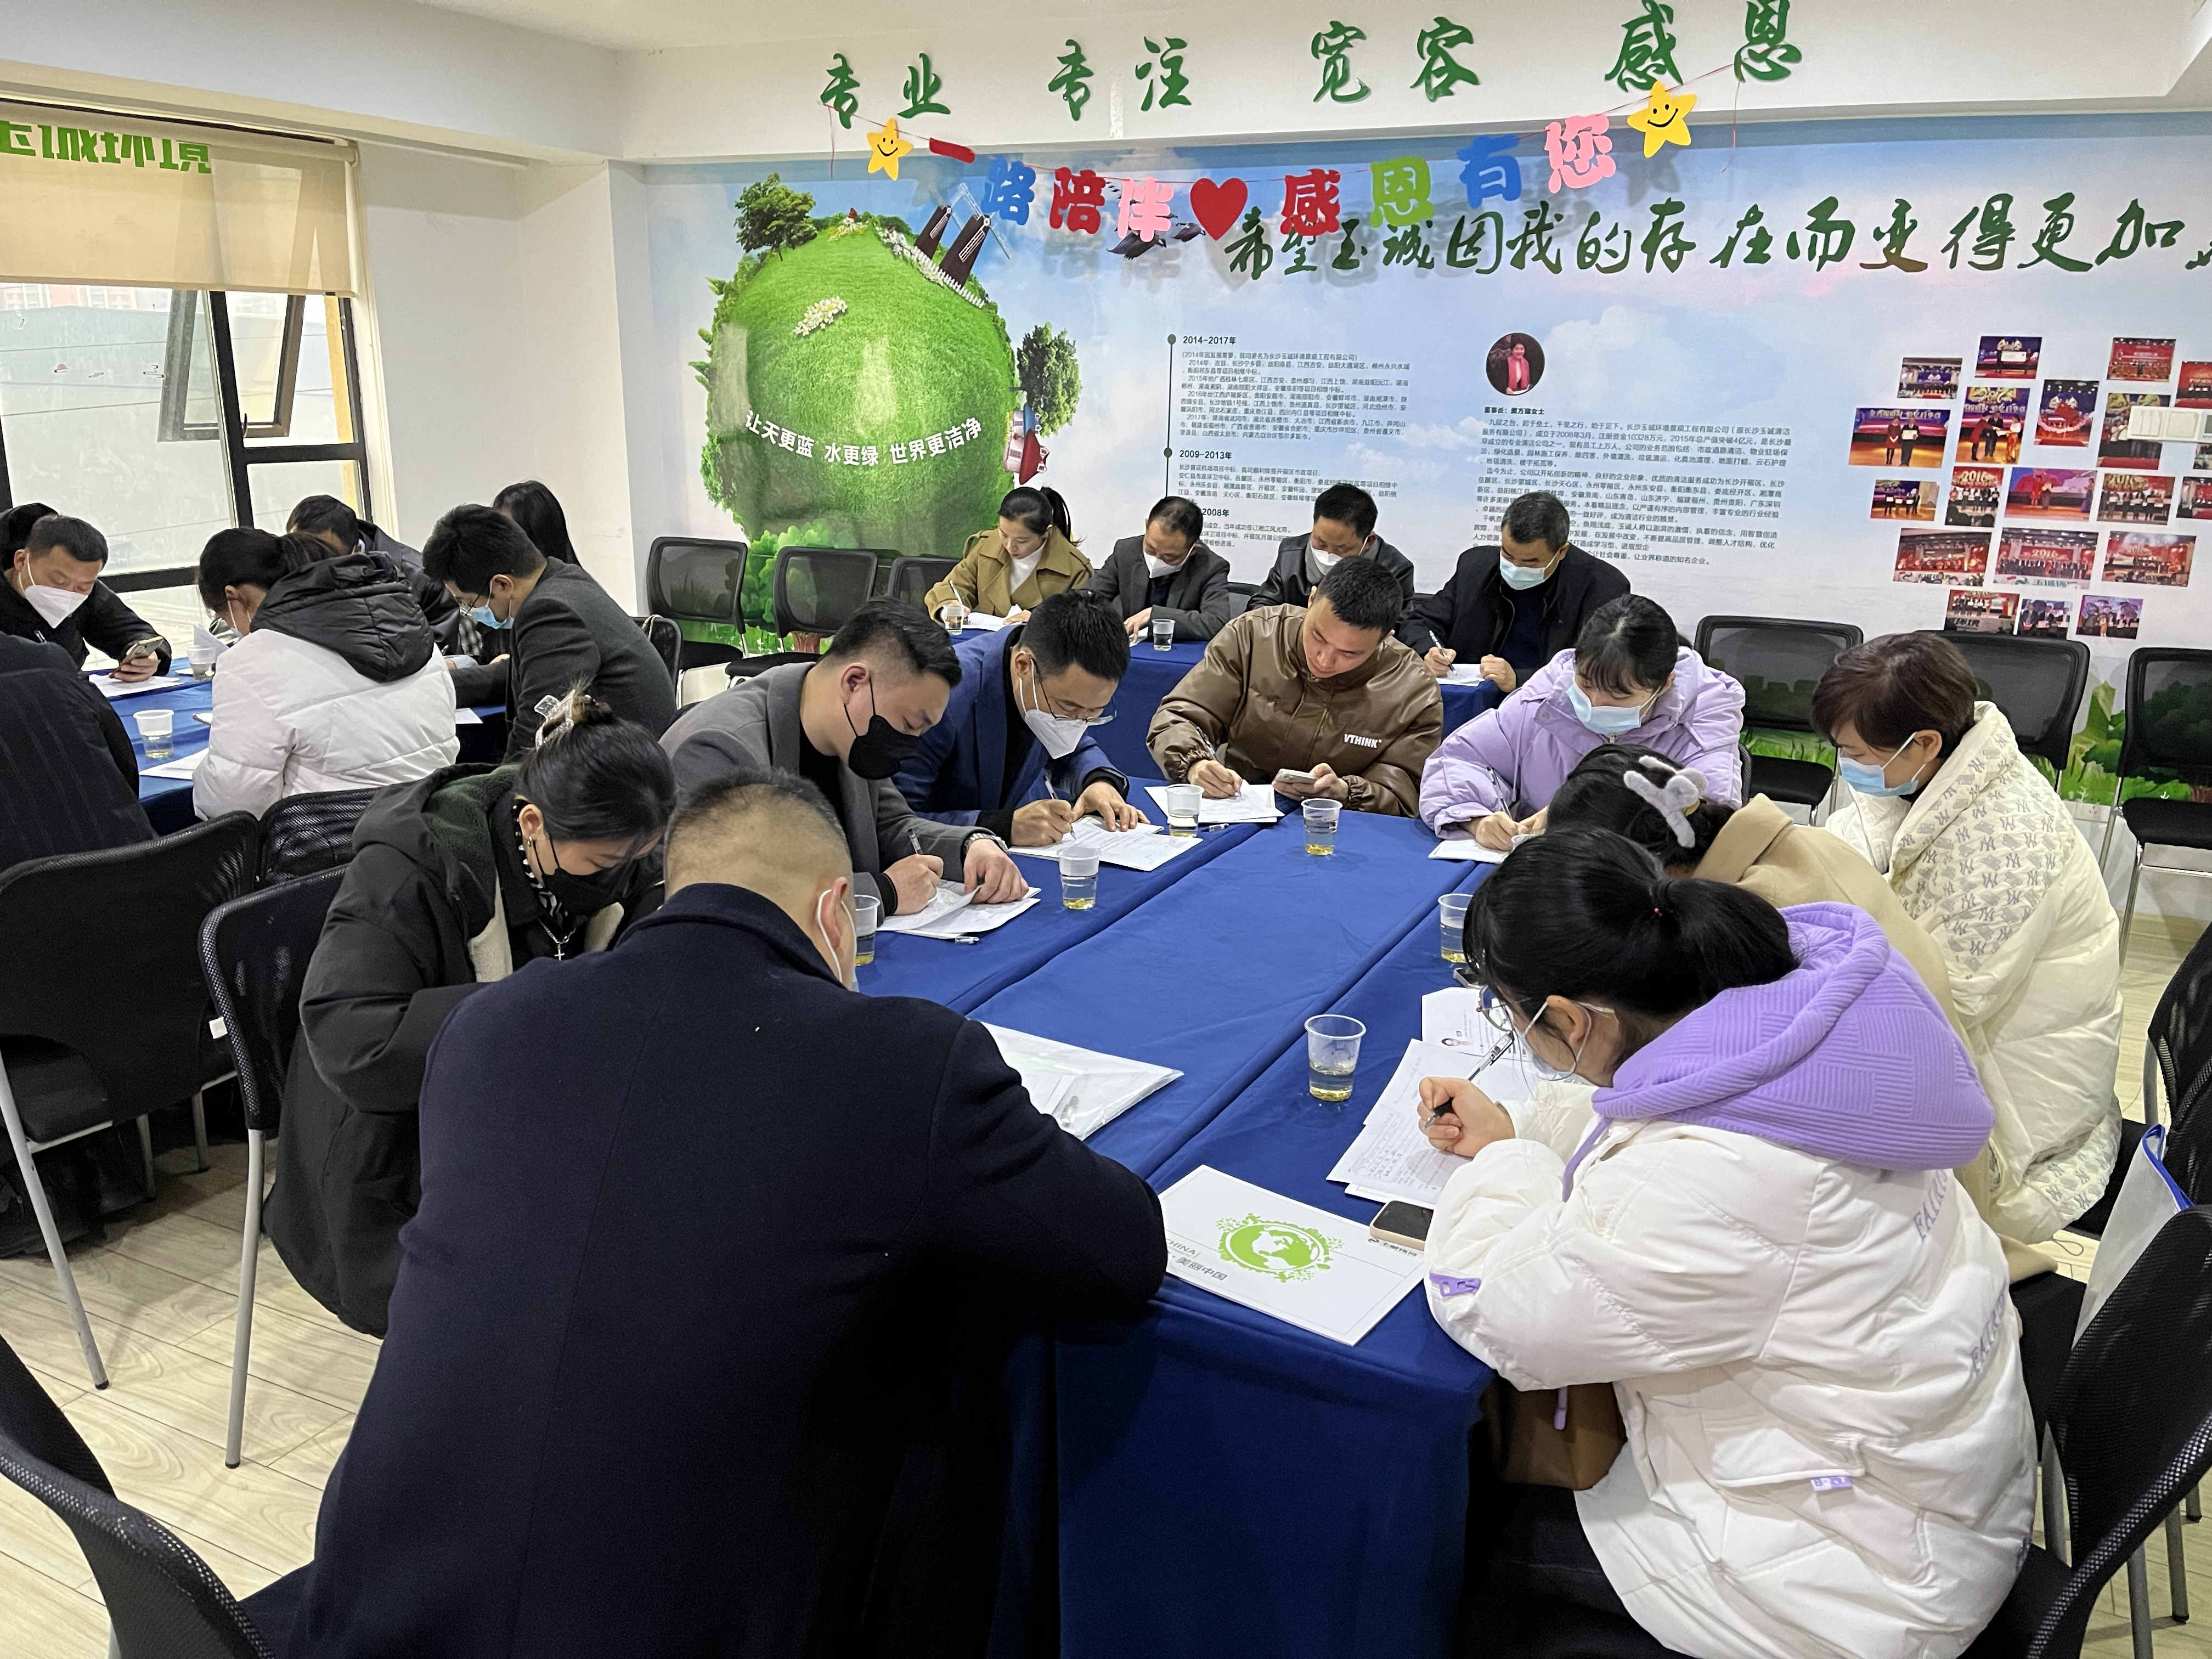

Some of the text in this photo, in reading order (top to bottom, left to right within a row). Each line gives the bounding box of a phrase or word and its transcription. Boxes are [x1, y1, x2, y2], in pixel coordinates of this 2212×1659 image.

[820, 0, 1802, 129] 专业 专注 宽容 感恩
[1280, 113, 1617, 236] 感恩有您
[1183, 336, 1237, 346] 2014-2017年
[744, 409, 983, 467] 让天更蓝 水更绿 世界更洁净
[1179, 449, 1232, 460] 2009-2013年
[1344, 733, 1379, 748] VTHINK
